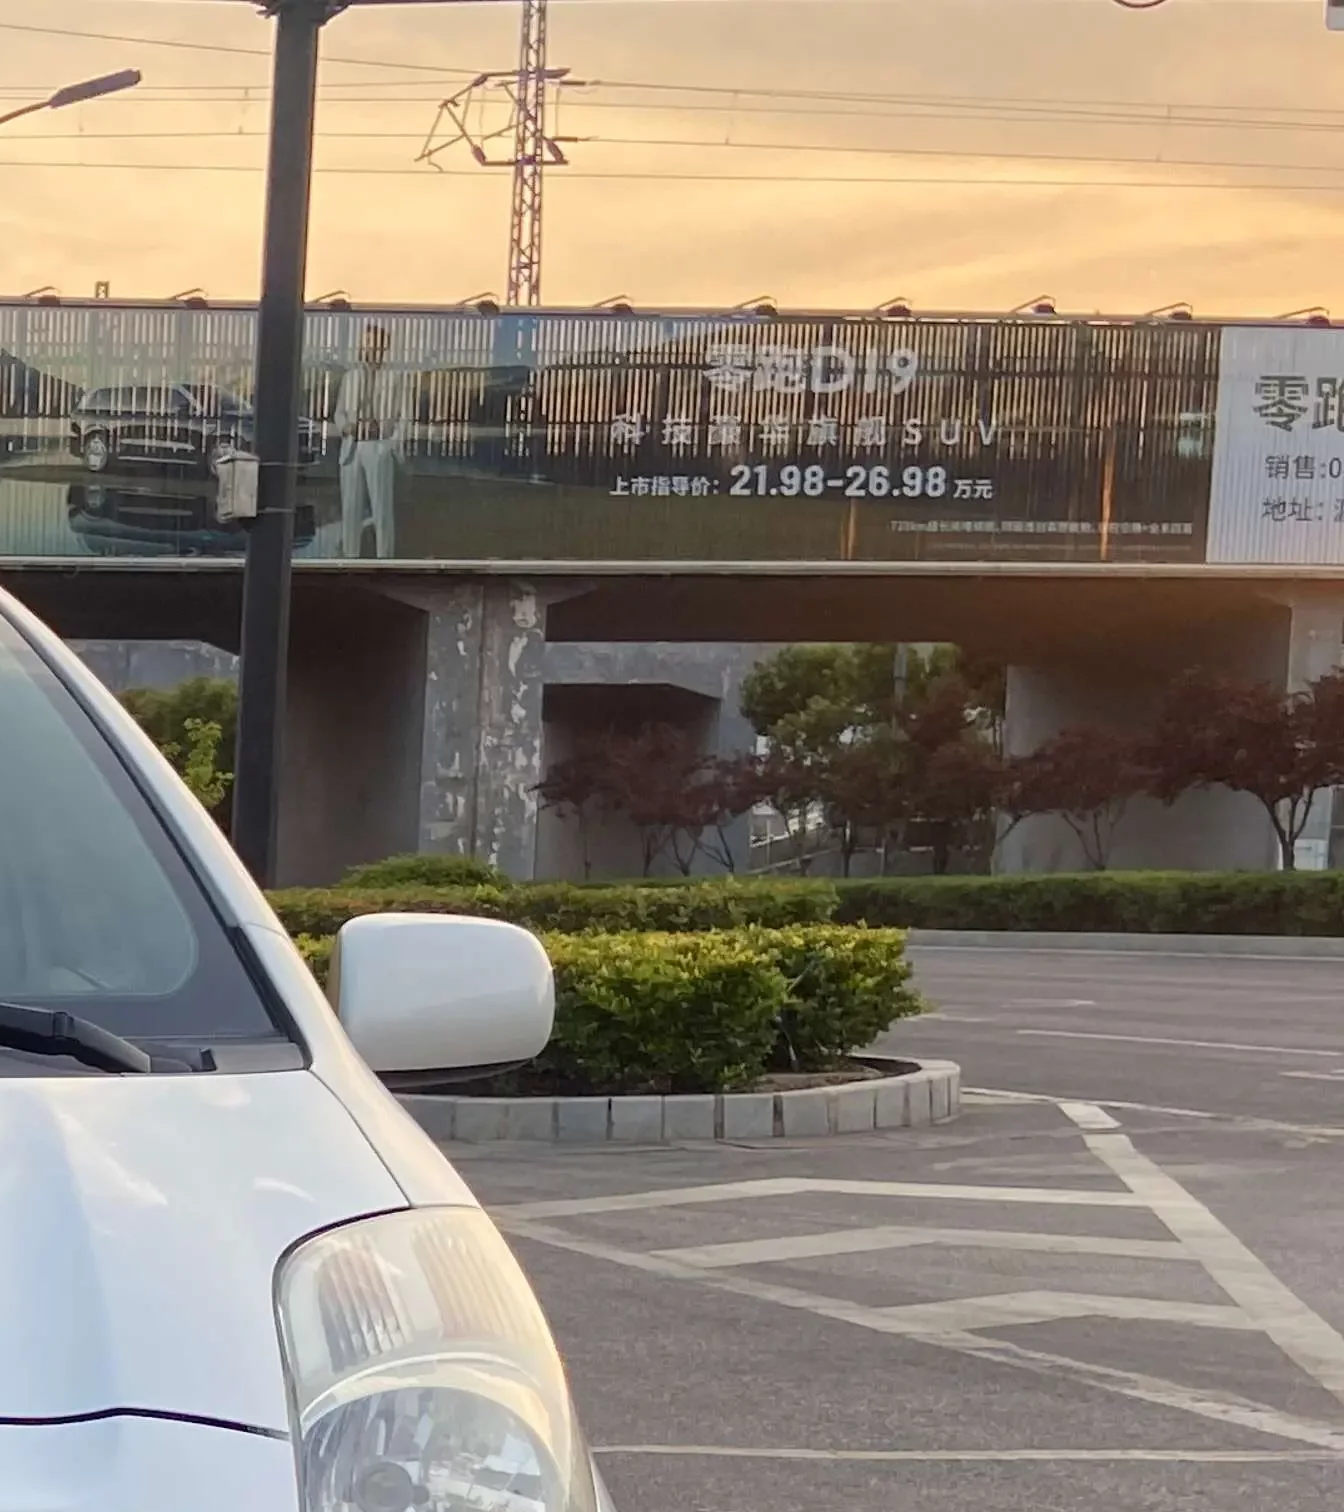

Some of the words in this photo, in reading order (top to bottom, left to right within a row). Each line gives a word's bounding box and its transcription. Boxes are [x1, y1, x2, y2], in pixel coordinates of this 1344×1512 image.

[702, 344, 919, 394] 零跑D19
[730, 464, 946, 497] 21.98-26.98
[953, 479, 993, 499] 万元
